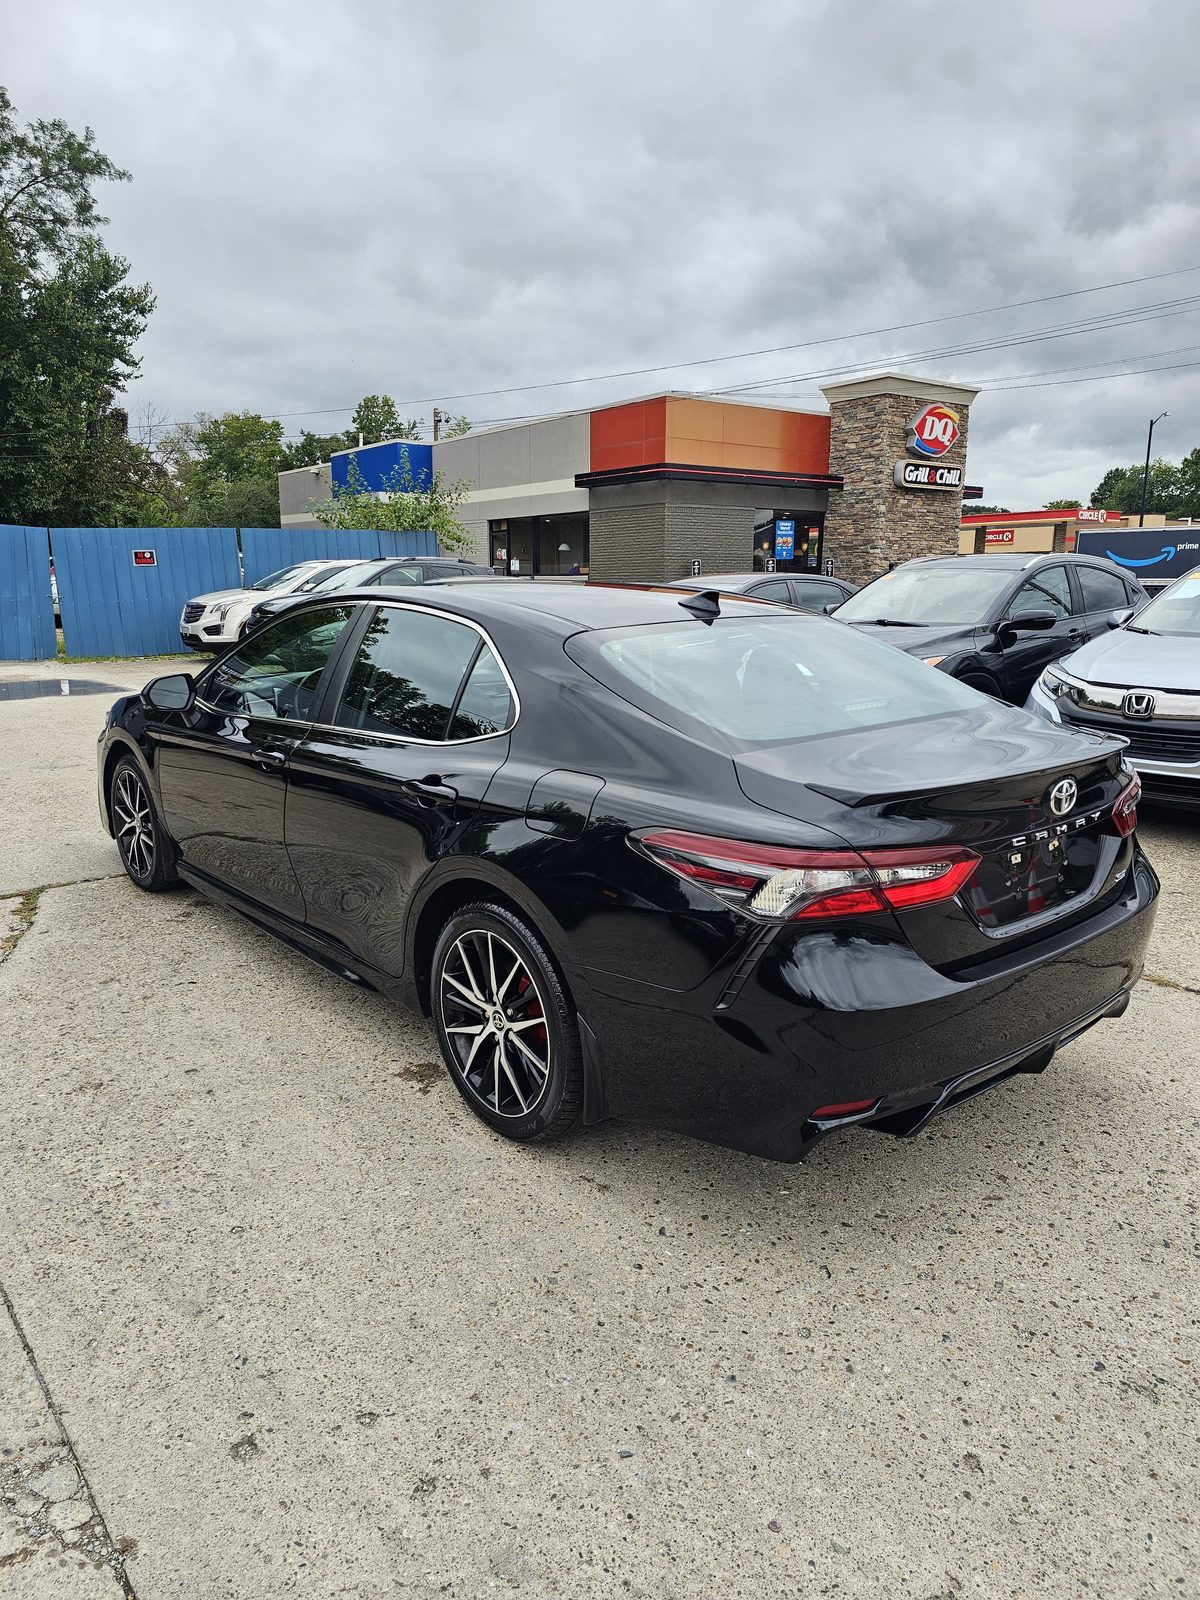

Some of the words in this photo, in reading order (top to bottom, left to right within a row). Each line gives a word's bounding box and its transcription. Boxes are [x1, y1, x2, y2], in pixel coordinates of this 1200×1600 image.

[922, 416, 953, 446] DQ
[1078, 511, 1098, 520] CIRCLE
[1177, 542, 1199, 551] prime
[1012, 811, 1101, 846] CAMRY
